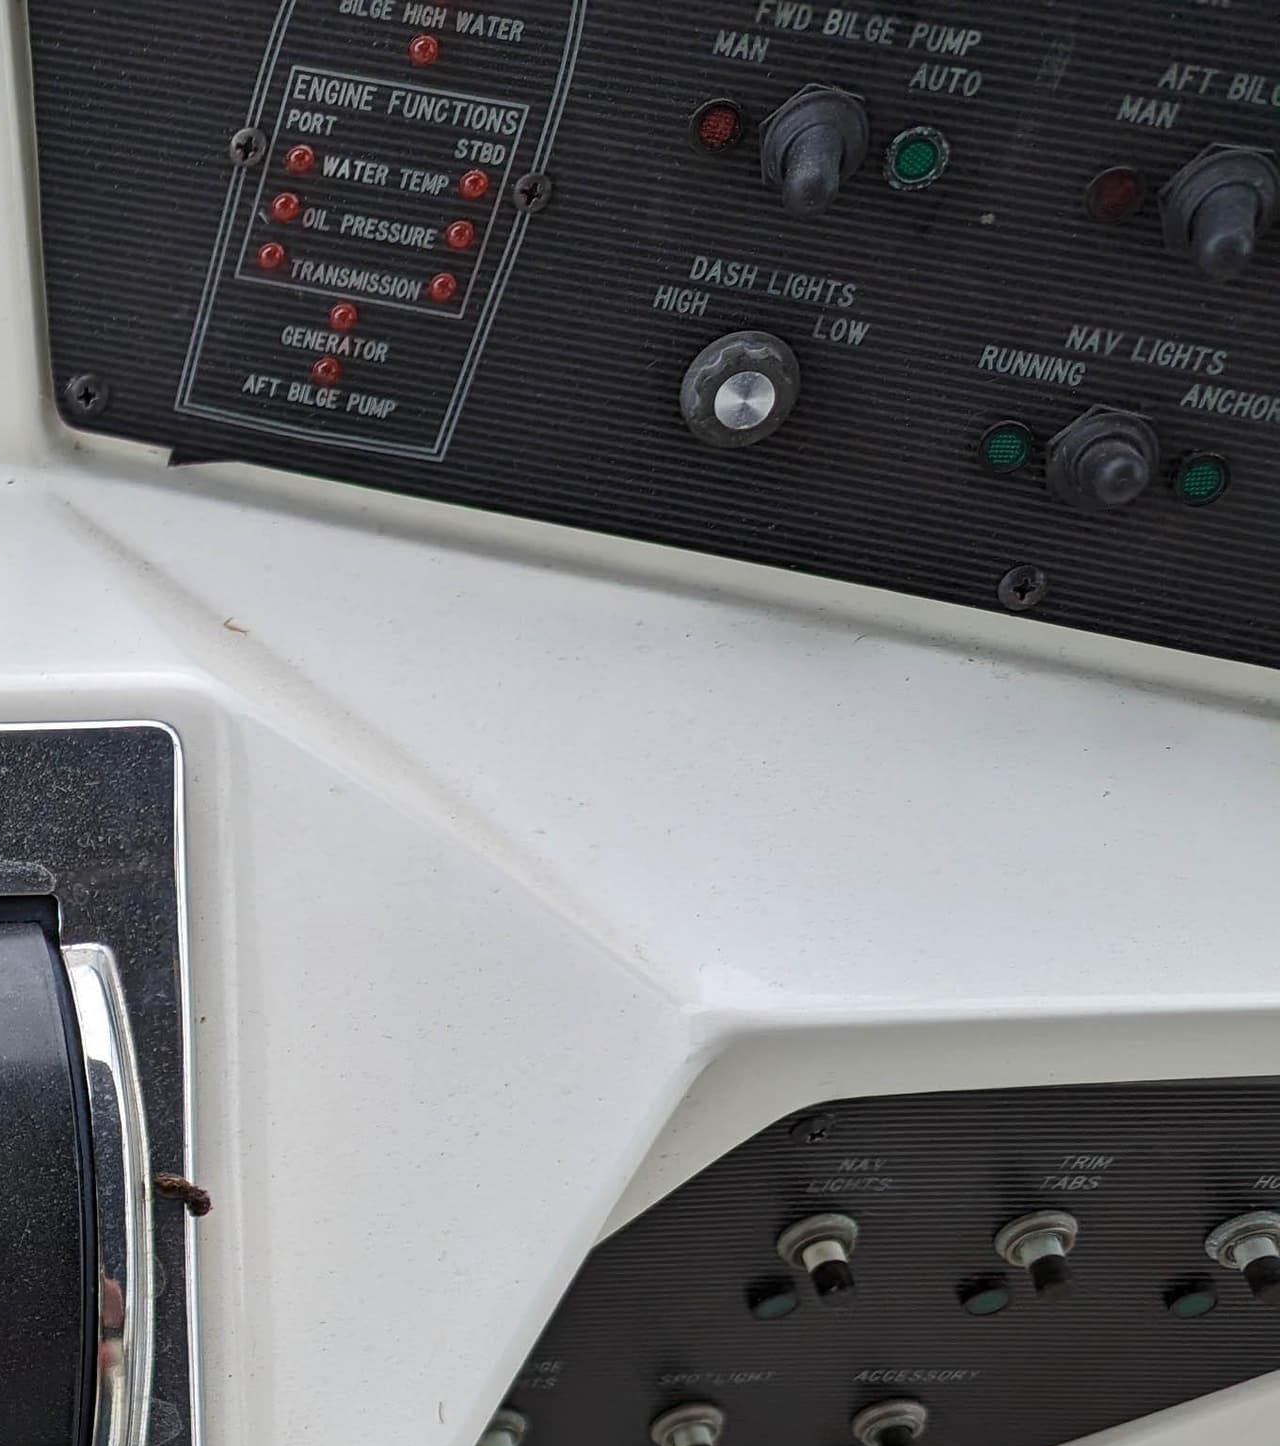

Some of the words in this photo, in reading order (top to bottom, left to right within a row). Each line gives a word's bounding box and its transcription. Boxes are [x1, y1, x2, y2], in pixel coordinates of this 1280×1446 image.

[339, 0, 393, 21] BILGE
[401, 2, 447, 29] HIGH
[454, 14, 525, 43] WATER
[754, 0, 814, 32] FWD
[821, 8, 896, 45] BILGE
[908, 23, 983, 57] PUMP
[712, 29, 770, 64] MAN
[909, 62, 983, 97] AUTO
[1157, 62, 1220, 95] AFT
[286, 109, 338, 137] PORT
[292, 75, 377, 112] ENGINE
[386, 90, 520, 137] FUNCTIONS
[1116, 94, 1180, 129] MAN
[454, 138, 506, 166] STBD
[322, 155, 389, 187] WATER
[399, 168, 450, 197] TEMP
[302, 207, 330, 232] OIL
[340, 213, 438, 250] PRESSURE
[290, 258, 422, 301] TRANSMISSION
[689, 255, 759, 290] DASH
[767, 271, 857, 308] LIGHTS
[653, 284, 710, 317] HIGH
[281, 325, 389, 363] GENERATOR
[812, 315, 870, 346] LOW
[978, 344, 1086, 387] RUNNING
[1065, 324, 1124, 356] NAV
[1131, 335, 1228, 375] LIGHTS
[242, 373, 282, 398] AFT
[287, 382, 342, 410] BILGE
[346, 392, 398, 420] PUMP
[1058, 1155, 1116, 1171] TRIM
[1040, 1174, 1103, 1191] TABS
[853, 1367, 981, 1384] ACCESSORY
